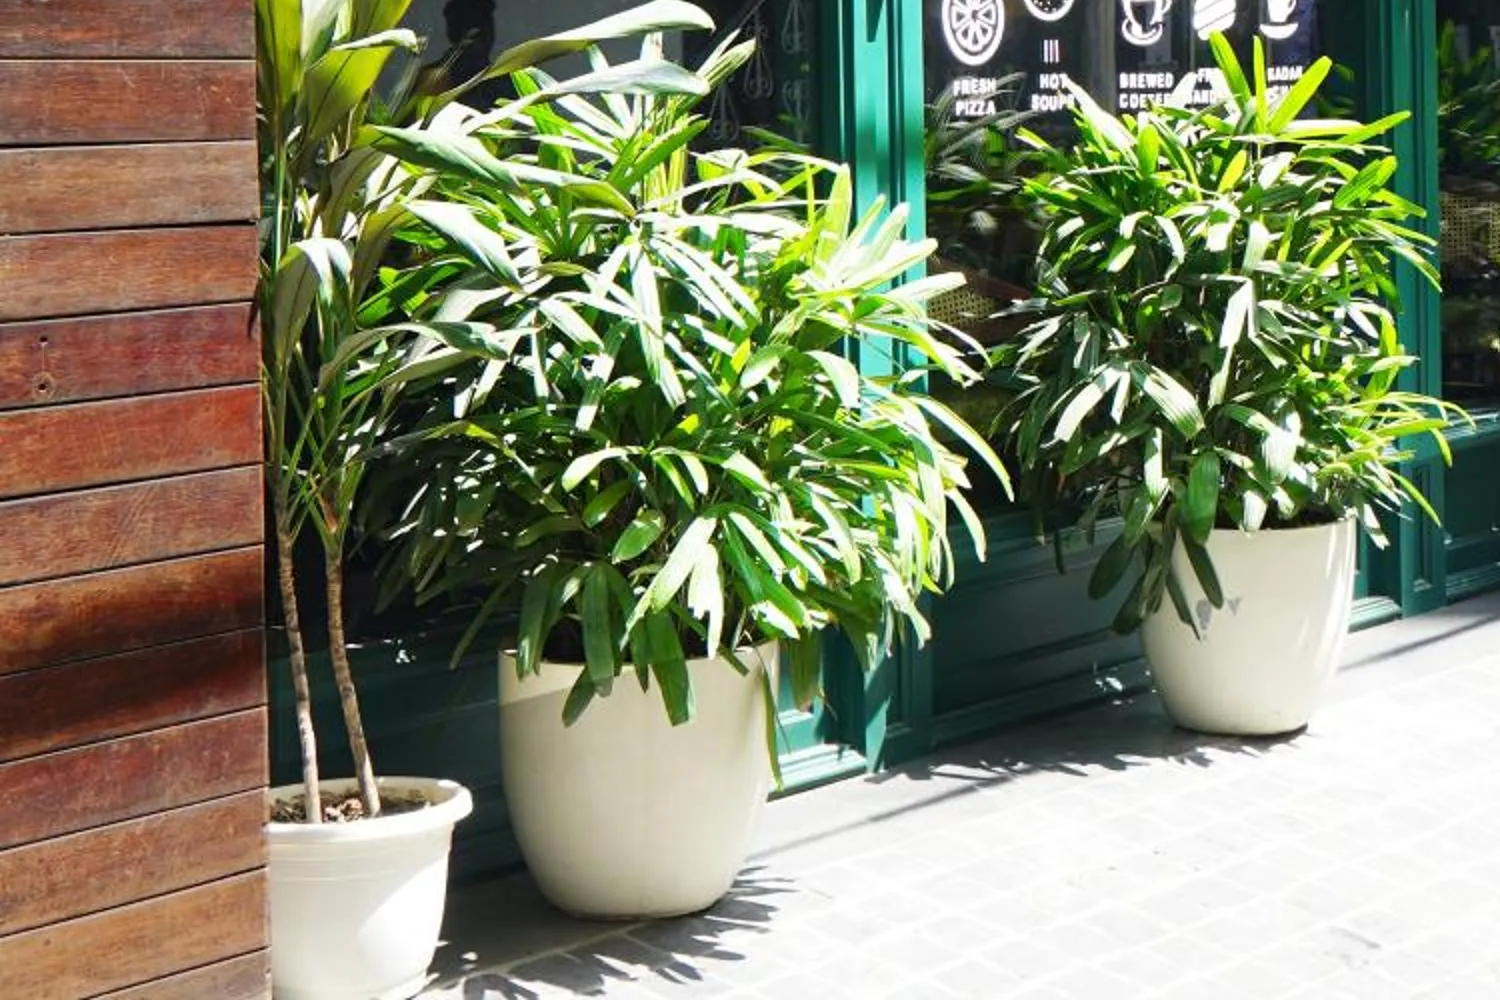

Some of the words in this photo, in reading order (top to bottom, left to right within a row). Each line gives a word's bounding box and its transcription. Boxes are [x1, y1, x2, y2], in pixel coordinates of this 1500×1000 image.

[953, 77, 997, 96] FRESH
[1039, 73, 1068, 89] HOT
[1119, 72, 1174, 88] BREWED
[955, 99, 996, 116] PIZZA
